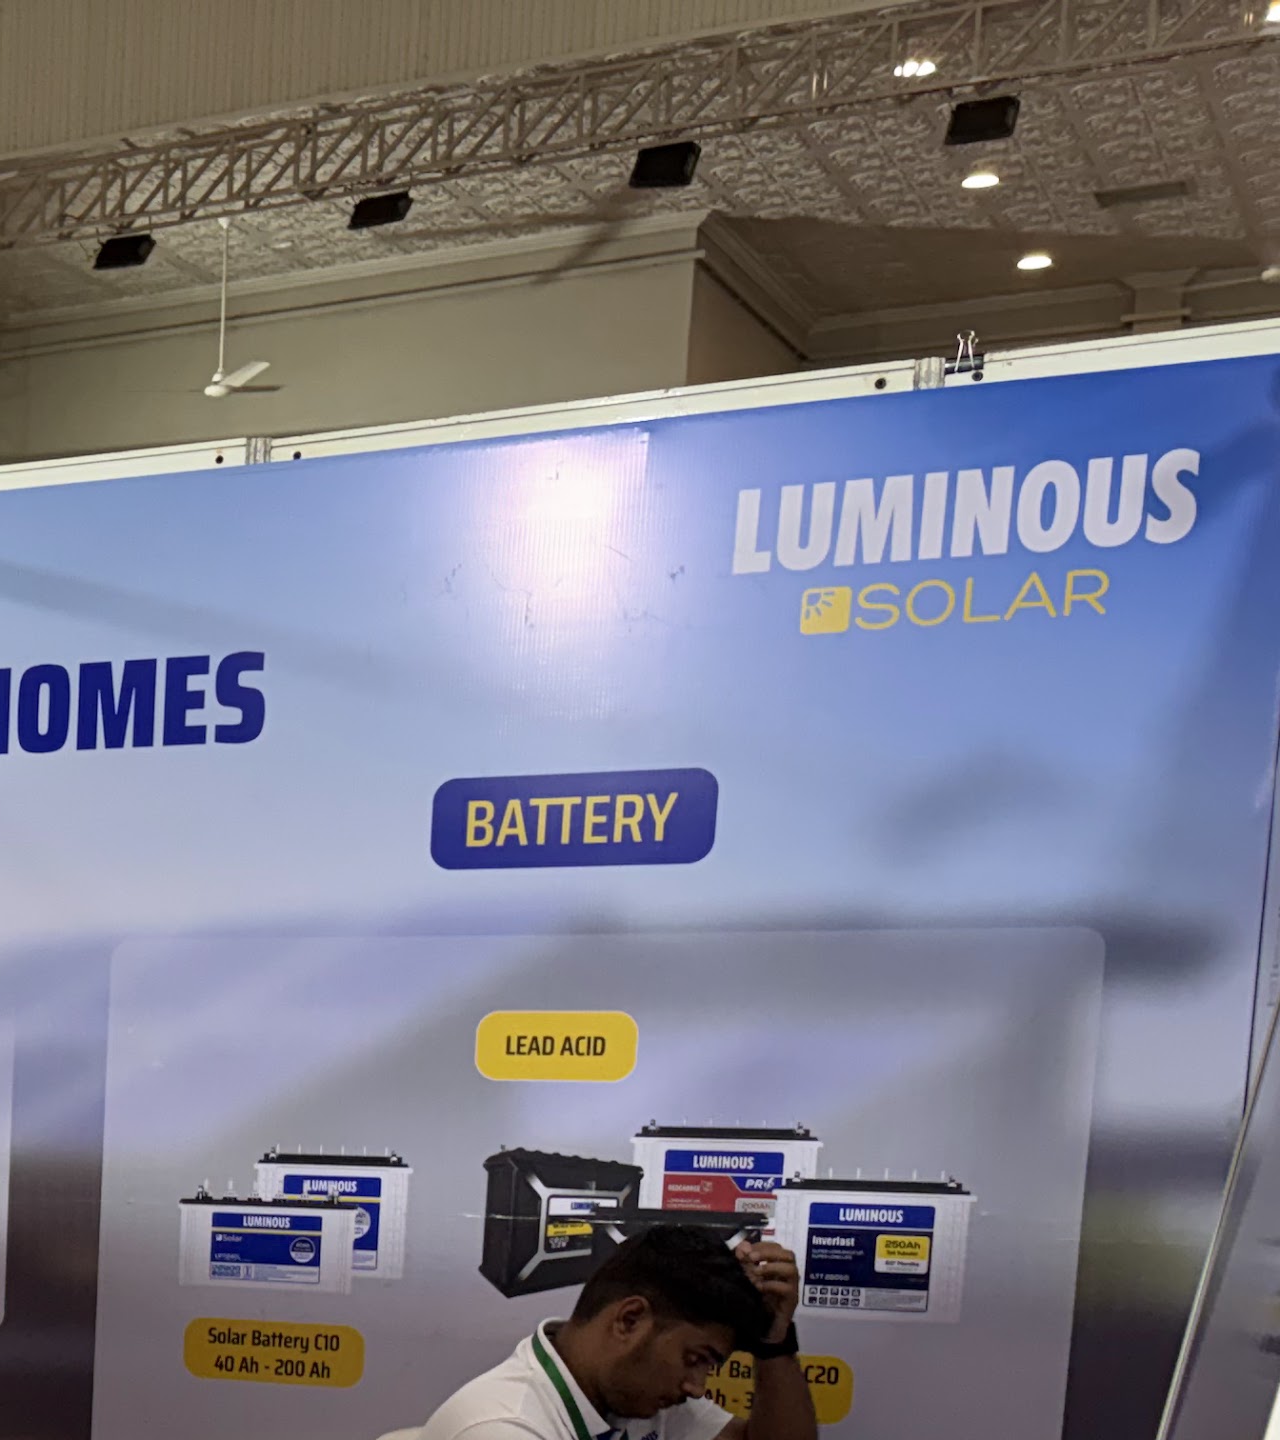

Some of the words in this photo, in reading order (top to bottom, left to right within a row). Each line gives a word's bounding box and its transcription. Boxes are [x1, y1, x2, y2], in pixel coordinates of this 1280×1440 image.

[732, 448, 1201, 575] LUMINOUS
[855, 569, 1110, 631] SOLAR
[464, 791, 679, 848] BATTERY
[505, 1034, 555, 1057] LEAD
[559, 1034, 607, 1057] ACID
[693, 1155, 755, 1170] LUMINOUS
[306, 1180, 357, 1193] LUMINOUS
[243, 1216, 291, 1228] LUMINOUS
[839, 1208, 904, 1223] LUMINOUS
[208, 1327, 247, 1345] Solar
[252, 1330, 310, 1353] Battery
[314, 1334, 340, 1352] C10
[214, 1356, 234, 1373] 40
[240, 1356, 259, 1374] Ah
[274, 1359, 305, 1377] 200
[309, 1360, 331, 1379] Ah
[805, 1365, 839, 1385] C20
